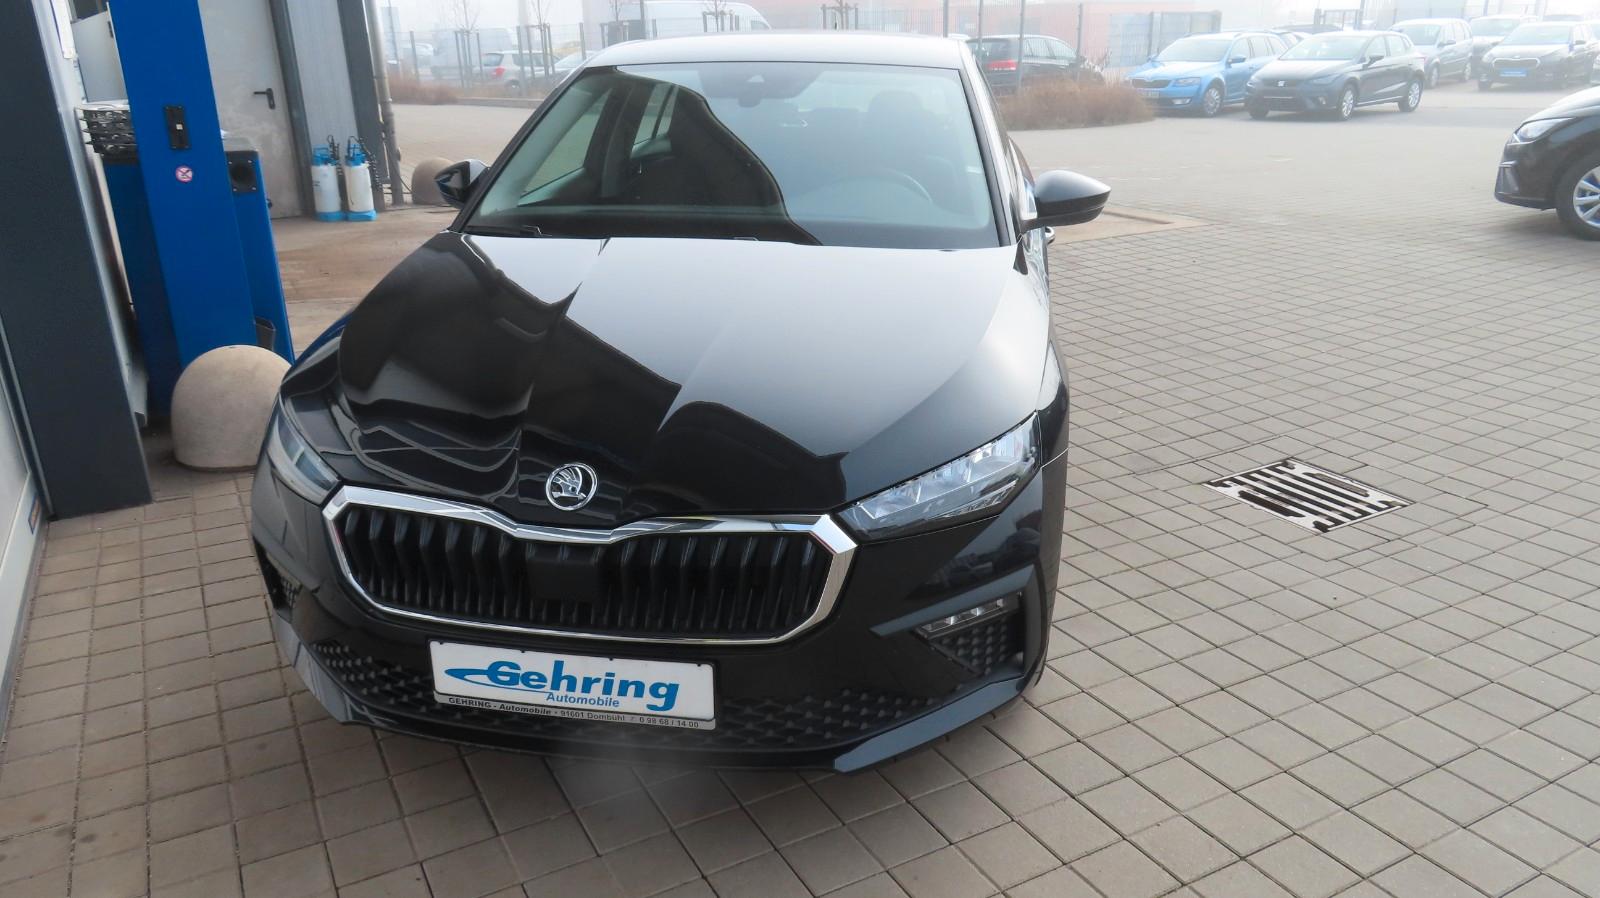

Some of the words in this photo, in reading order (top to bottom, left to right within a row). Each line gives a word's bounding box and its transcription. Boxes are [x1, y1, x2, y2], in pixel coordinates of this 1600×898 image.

[487, 660, 679, 712] Gehring
[448, 697, 491, 708] GEHRING
[499, 704, 551, 715] Automobile
[546, 692, 620, 707] Automobile
